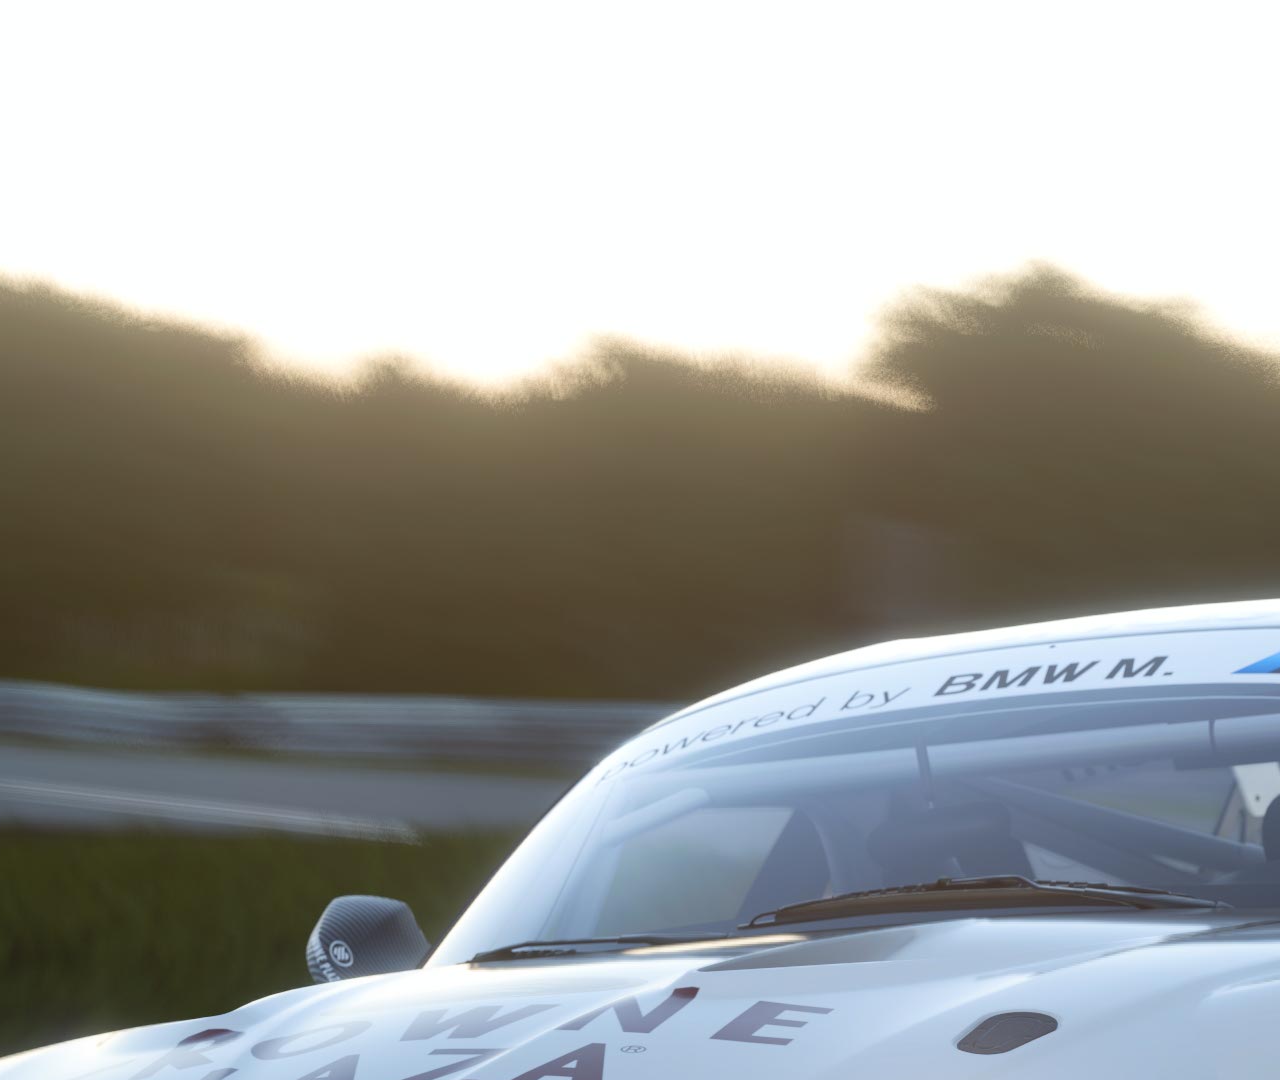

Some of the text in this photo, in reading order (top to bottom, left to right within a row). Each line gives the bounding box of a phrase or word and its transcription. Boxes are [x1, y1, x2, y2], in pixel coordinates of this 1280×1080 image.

[593, 696, 827, 786] powered
[839, 686, 911, 710] by
[932, 660, 1099, 698] BMW
